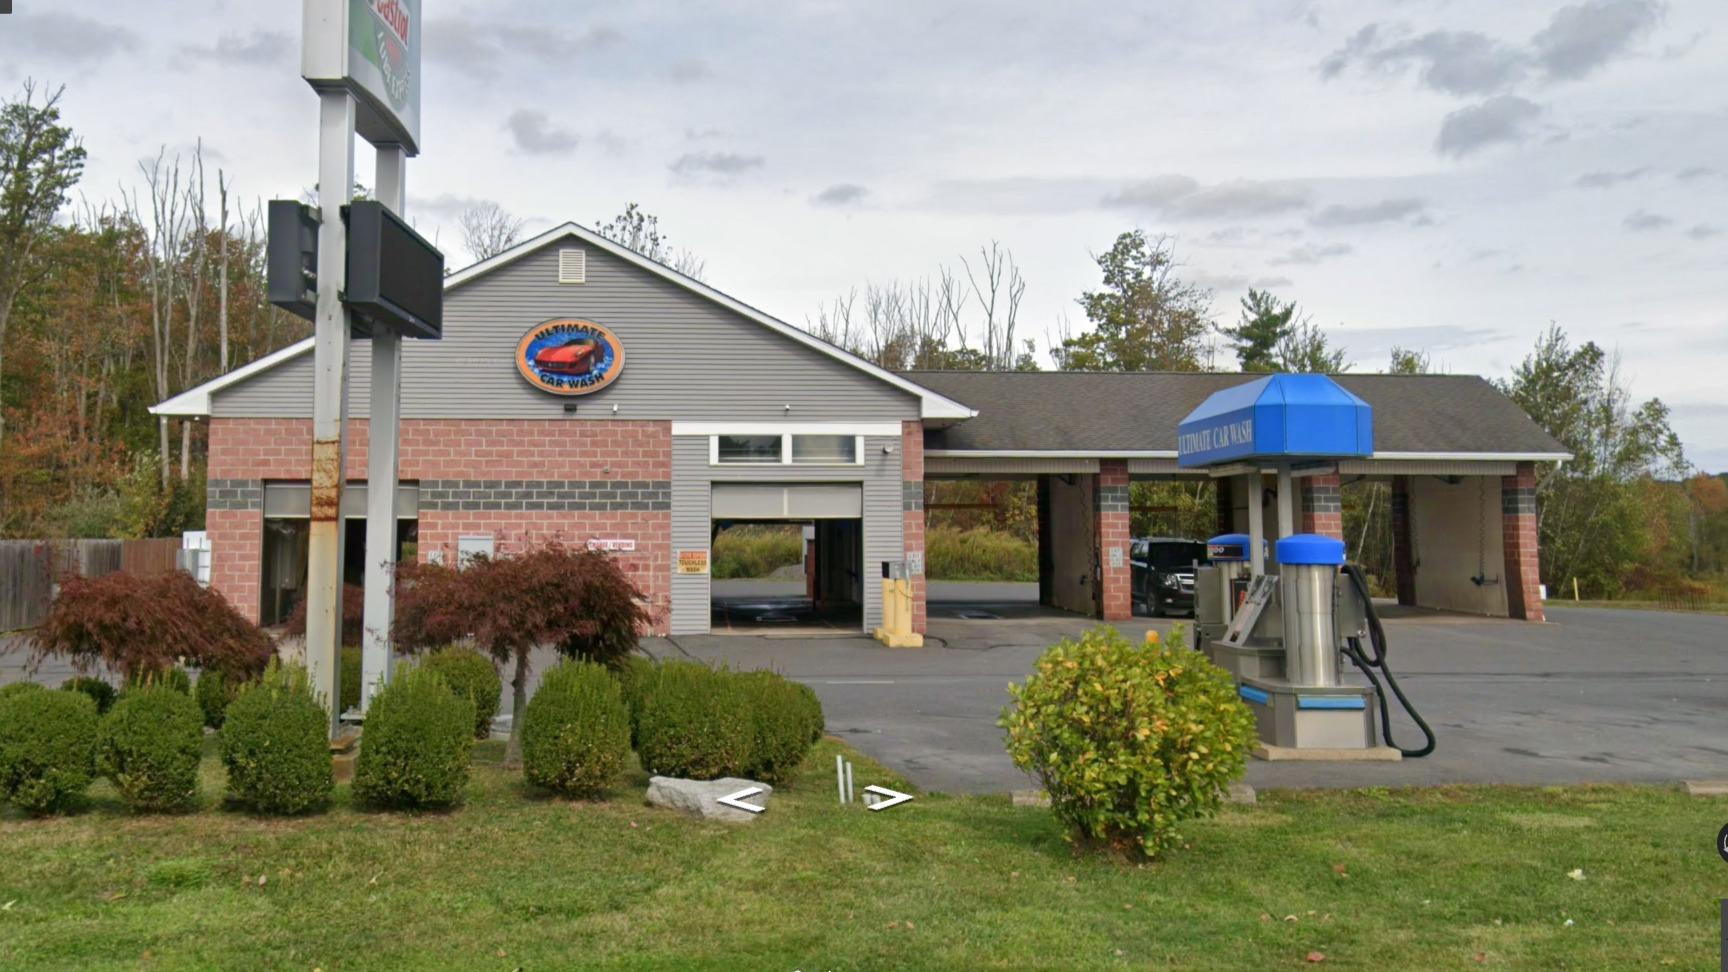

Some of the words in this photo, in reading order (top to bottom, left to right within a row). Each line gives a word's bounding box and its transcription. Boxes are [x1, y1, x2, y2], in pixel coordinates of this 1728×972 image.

[535, 324, 606, 340] ULTIMATE
[540, 374, 563, 387] CAR
[568, 372, 605, 388] WASH
[1178, 429, 1211, 456] ULTIMATE
[1213, 426, 1229, 449] CAR
[1229, 419, 1252, 444] WASH
